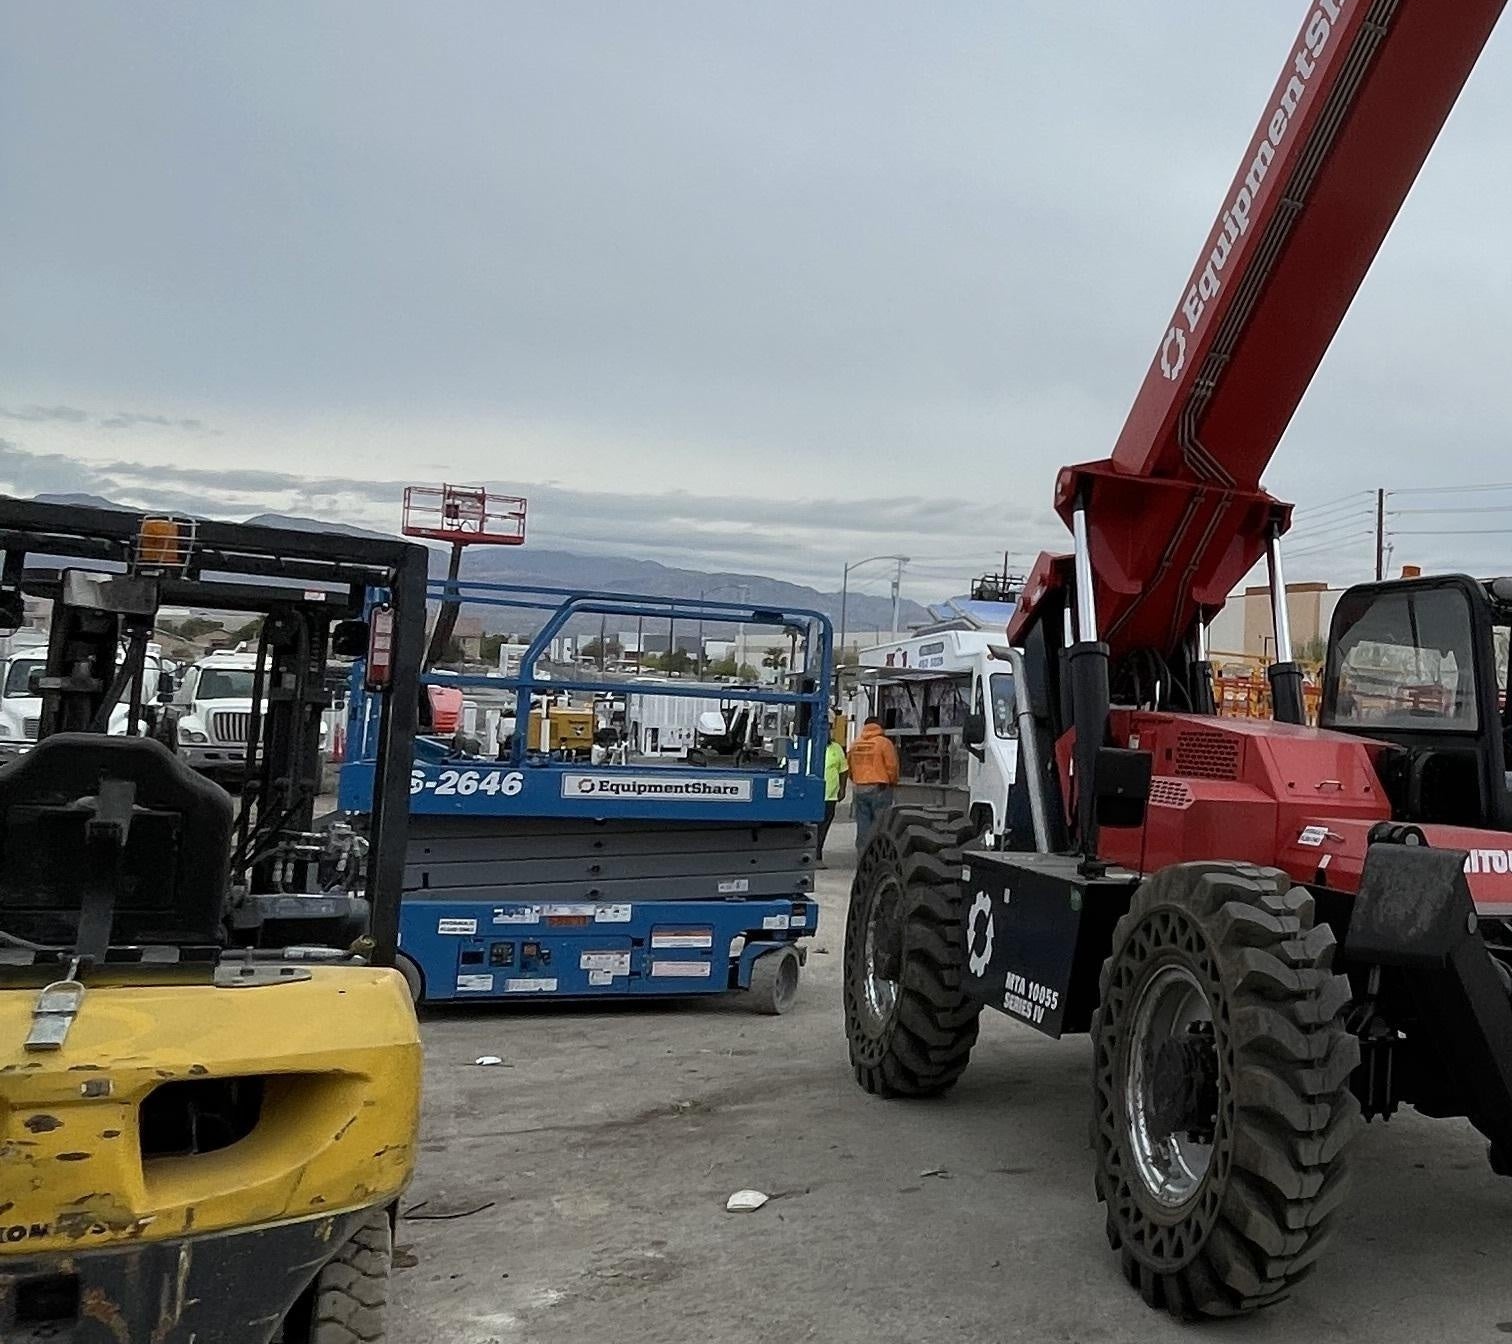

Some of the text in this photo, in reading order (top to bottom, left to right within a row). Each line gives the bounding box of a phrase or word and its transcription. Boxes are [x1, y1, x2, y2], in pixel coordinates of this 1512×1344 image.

[599, 779, 739, 796] EquipmentShare
[1005, 971, 1059, 1010] MTA 10055
[1003, 992, 1045, 1024] SERIES IV
